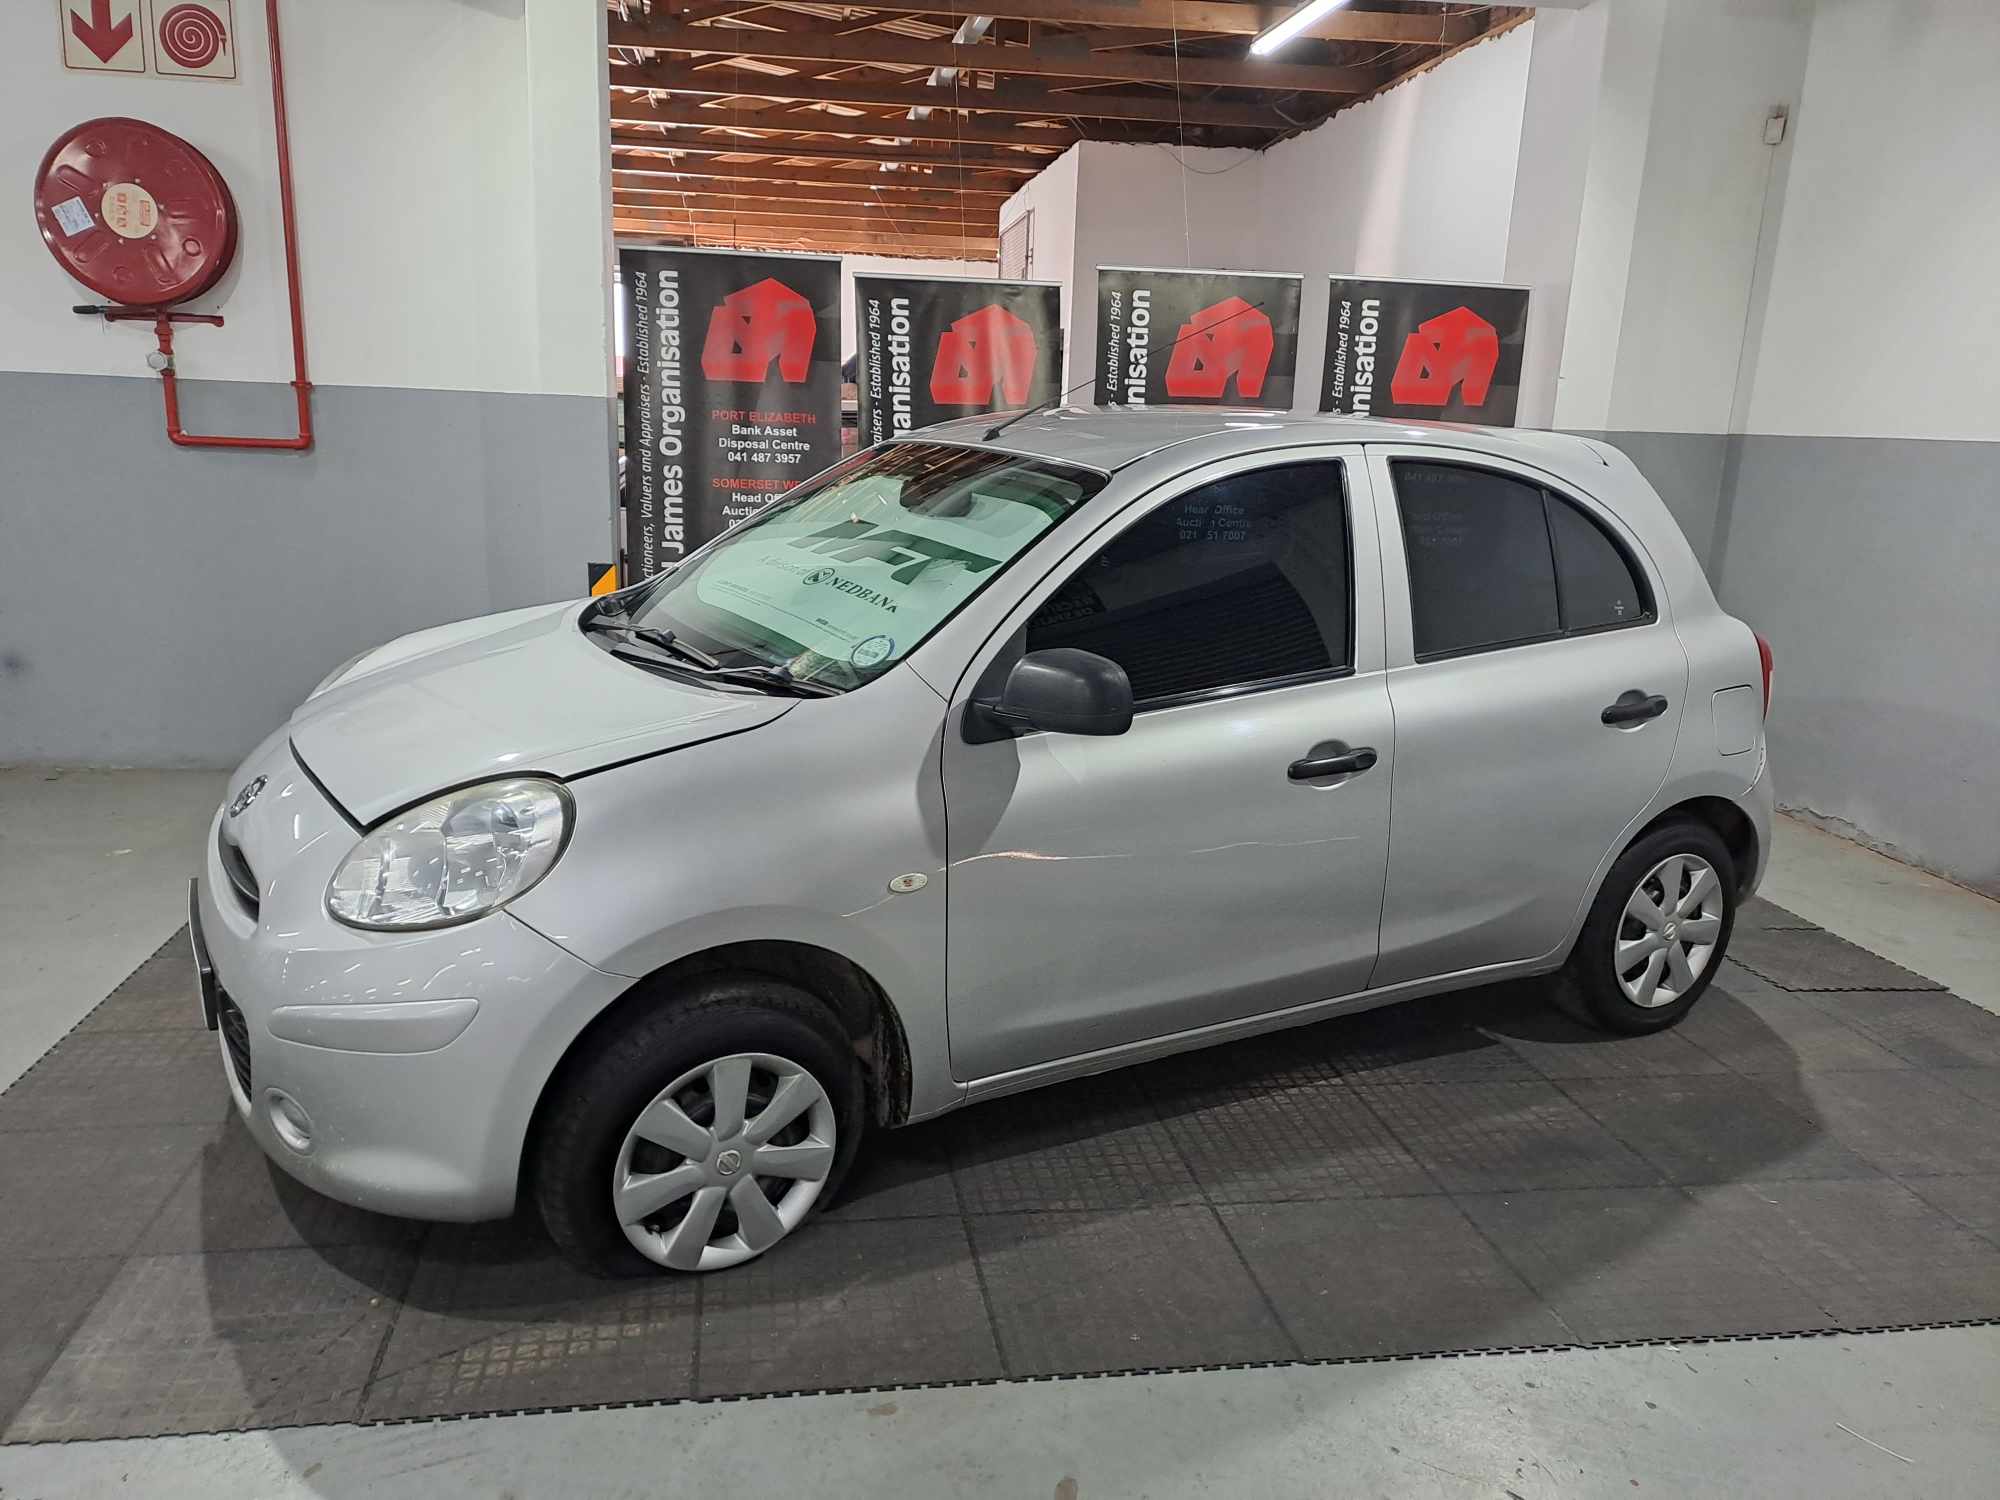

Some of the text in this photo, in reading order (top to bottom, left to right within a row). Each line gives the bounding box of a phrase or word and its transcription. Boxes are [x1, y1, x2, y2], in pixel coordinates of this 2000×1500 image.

[635, 271, 647, 304] 1964
[868, 299, 880, 329] 1964
[1110, 291, 1122, 320] 1964
[1339, 300, 1352, 329] 1964
[635, 305, 649, 374] Established
[656, 270, 685, 456] Organisation
[868, 331, 882, 399] Established
[1106, 323, 1120, 391] Established
[1332, 332, 1348, 398] Established
[638, 384, 653, 446] Appraisers
[712, 409, 816, 424] PORT ELIZABETH
[719, 438, 810, 451] Disposal Centre
[731, 424, 797, 437] Bank Asset
[639, 449, 652, 472] and
[727, 451, 801, 464] 041 487 3957
[640, 476, 653, 518] Valuers
[712, 478, 778, 490] SOMERSET
[731, 492, 761, 503] Head
[661, 465, 684, 554] James
